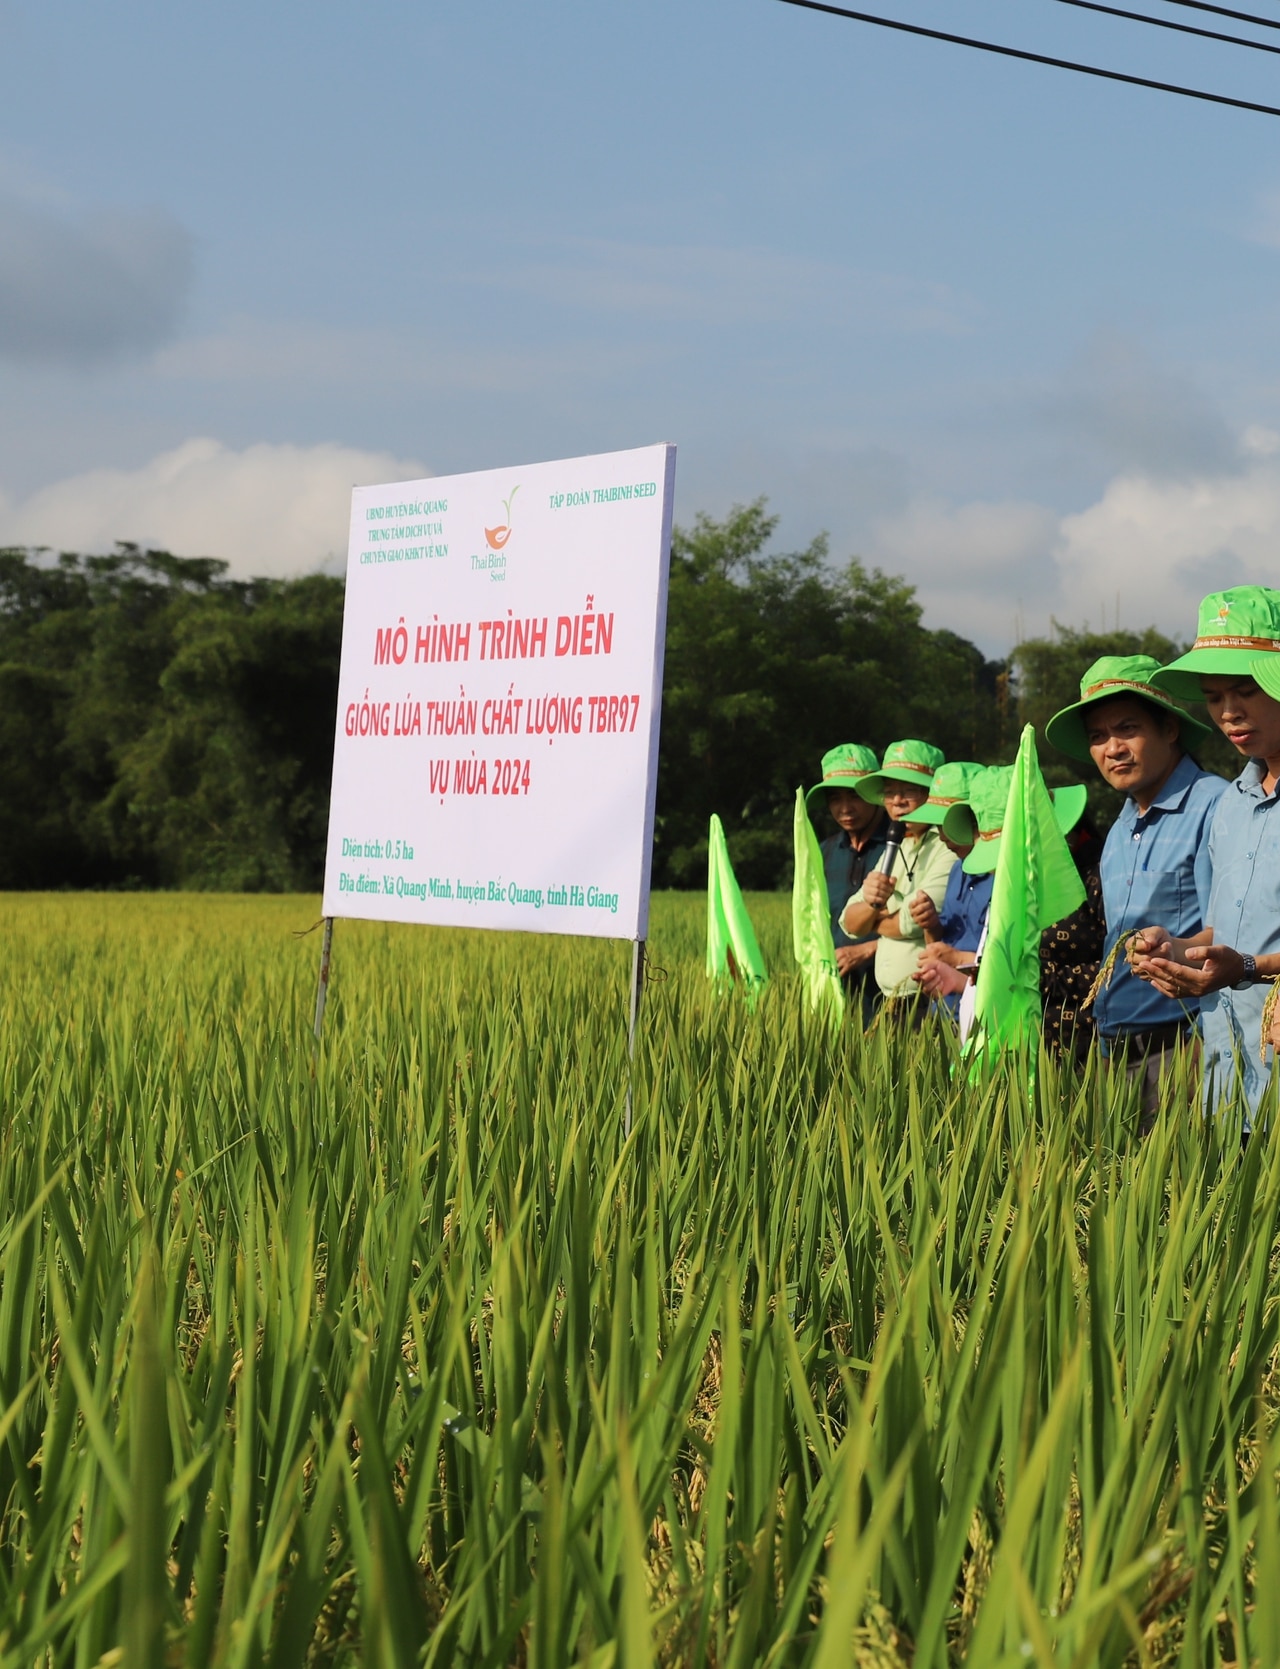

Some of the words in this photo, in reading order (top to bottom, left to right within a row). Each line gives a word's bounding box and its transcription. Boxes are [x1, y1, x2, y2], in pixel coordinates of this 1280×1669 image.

[566, 488, 590, 506] ĐOÀN
[593, 485, 633, 503] THAIBINH
[634, 482, 657, 498] SEED
[423, 499, 448, 516] QUANG
[368, 528, 390, 542] TRUNG
[387, 548, 404, 562] GIAO
[405, 547, 424, 560] KHKT
[435, 544, 448, 558] NLN
[490, 569, 506, 582] Seed
[374, 616, 408, 665] MÔ
[414, 614, 471, 663] HÌNH
[478, 609, 548, 661] TRÌNH
[554, 594, 614, 657] DIỄN
[345, 687, 390, 736] GIỐNG
[394, 693, 421, 736] LÚA
[427, 684, 478, 736] THUẦN
[482, 682, 523, 735] CHẤT
[526, 692, 583, 745] LƯỢNG
[588, 694, 640, 733] TBR97
[430, 759, 450, 805] VỤ
[453, 750, 487, 795] MÙA
[492, 759, 530, 795] 2024
[342, 838, 362, 862] Diện
[364, 839, 384, 859] tích:
[385, 840, 401, 860] 0.5
[402, 840, 414, 860] ha
[339, 872, 354, 897] Địa
[382, 875, 394, 895] Xã
[396, 876, 427, 901] Quang
[428, 877, 454, 901] Minh,
[456, 879, 485, 906] huyện
[487, 875, 506, 902] Bắc
[508, 881, 545, 908] Quang,
[569, 885, 585, 907] Hà
[587, 886, 619, 913] Giang
